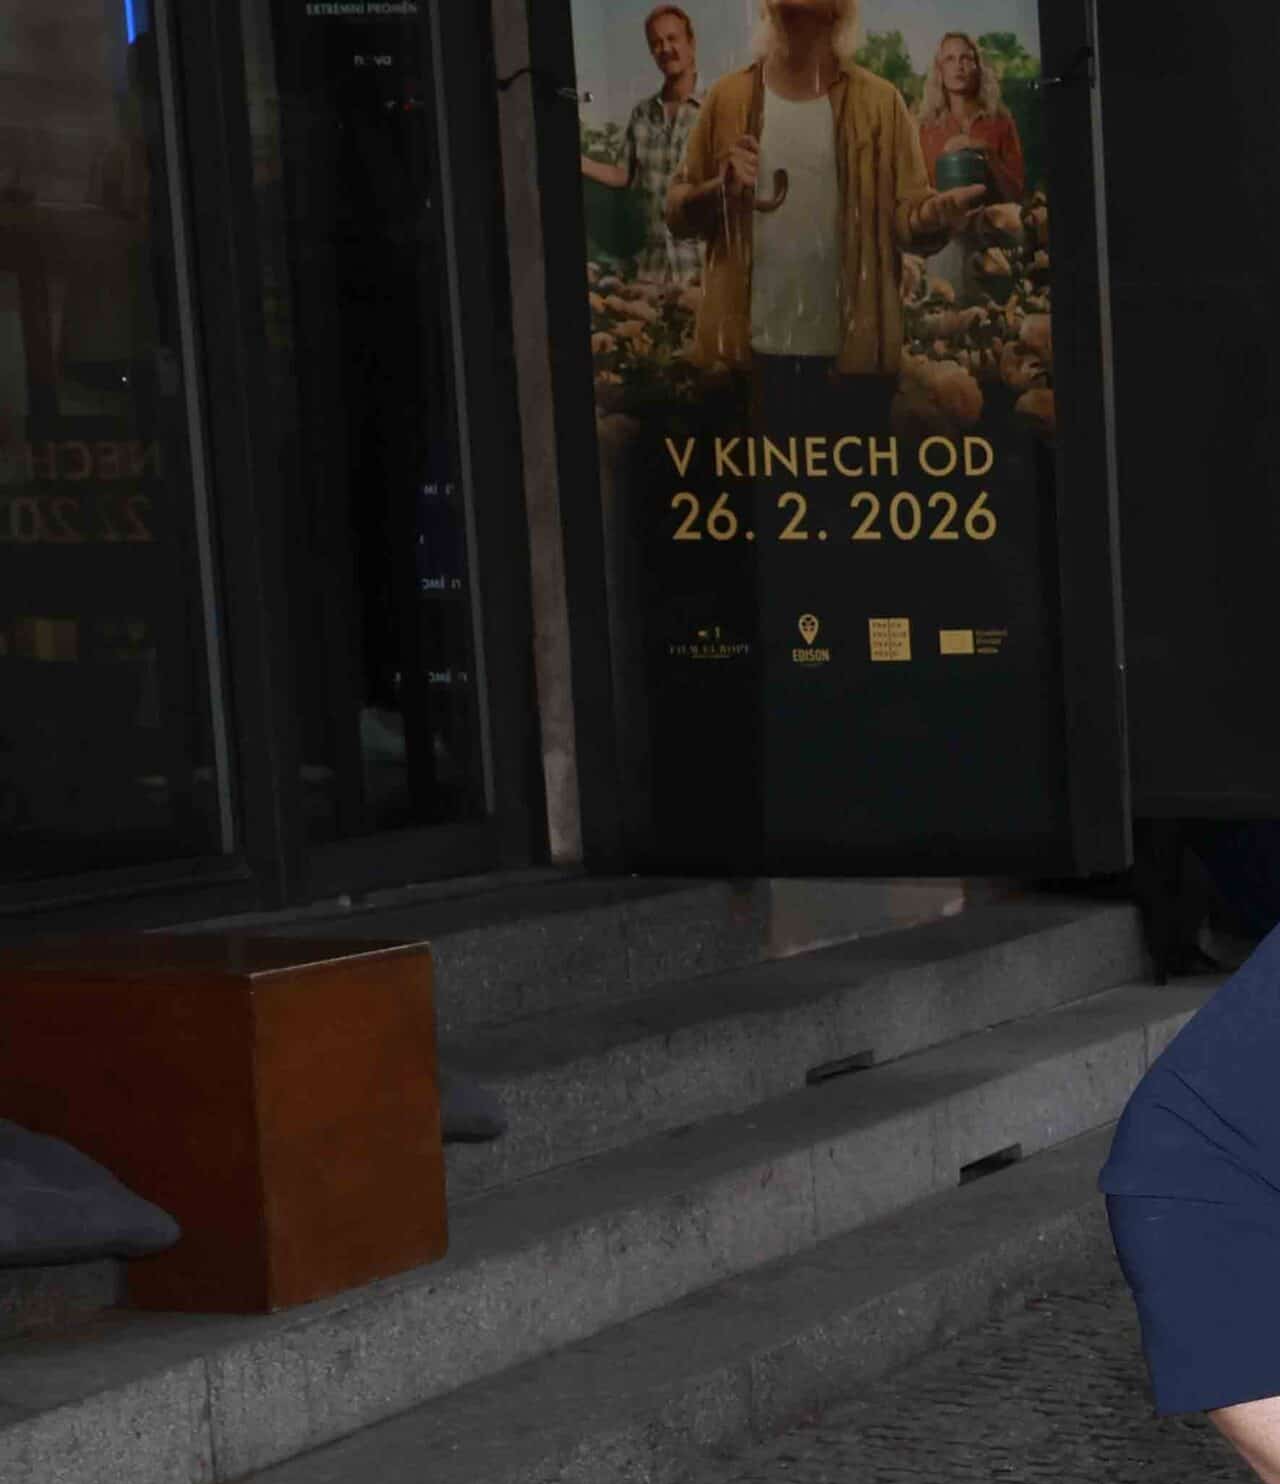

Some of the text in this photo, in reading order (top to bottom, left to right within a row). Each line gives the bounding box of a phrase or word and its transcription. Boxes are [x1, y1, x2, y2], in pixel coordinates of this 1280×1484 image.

[665, 435, 995, 479] V KINECH OD
[671, 490, 997, 542] 26. 2. 2026
[792, 647, 830, 663] EDISON
